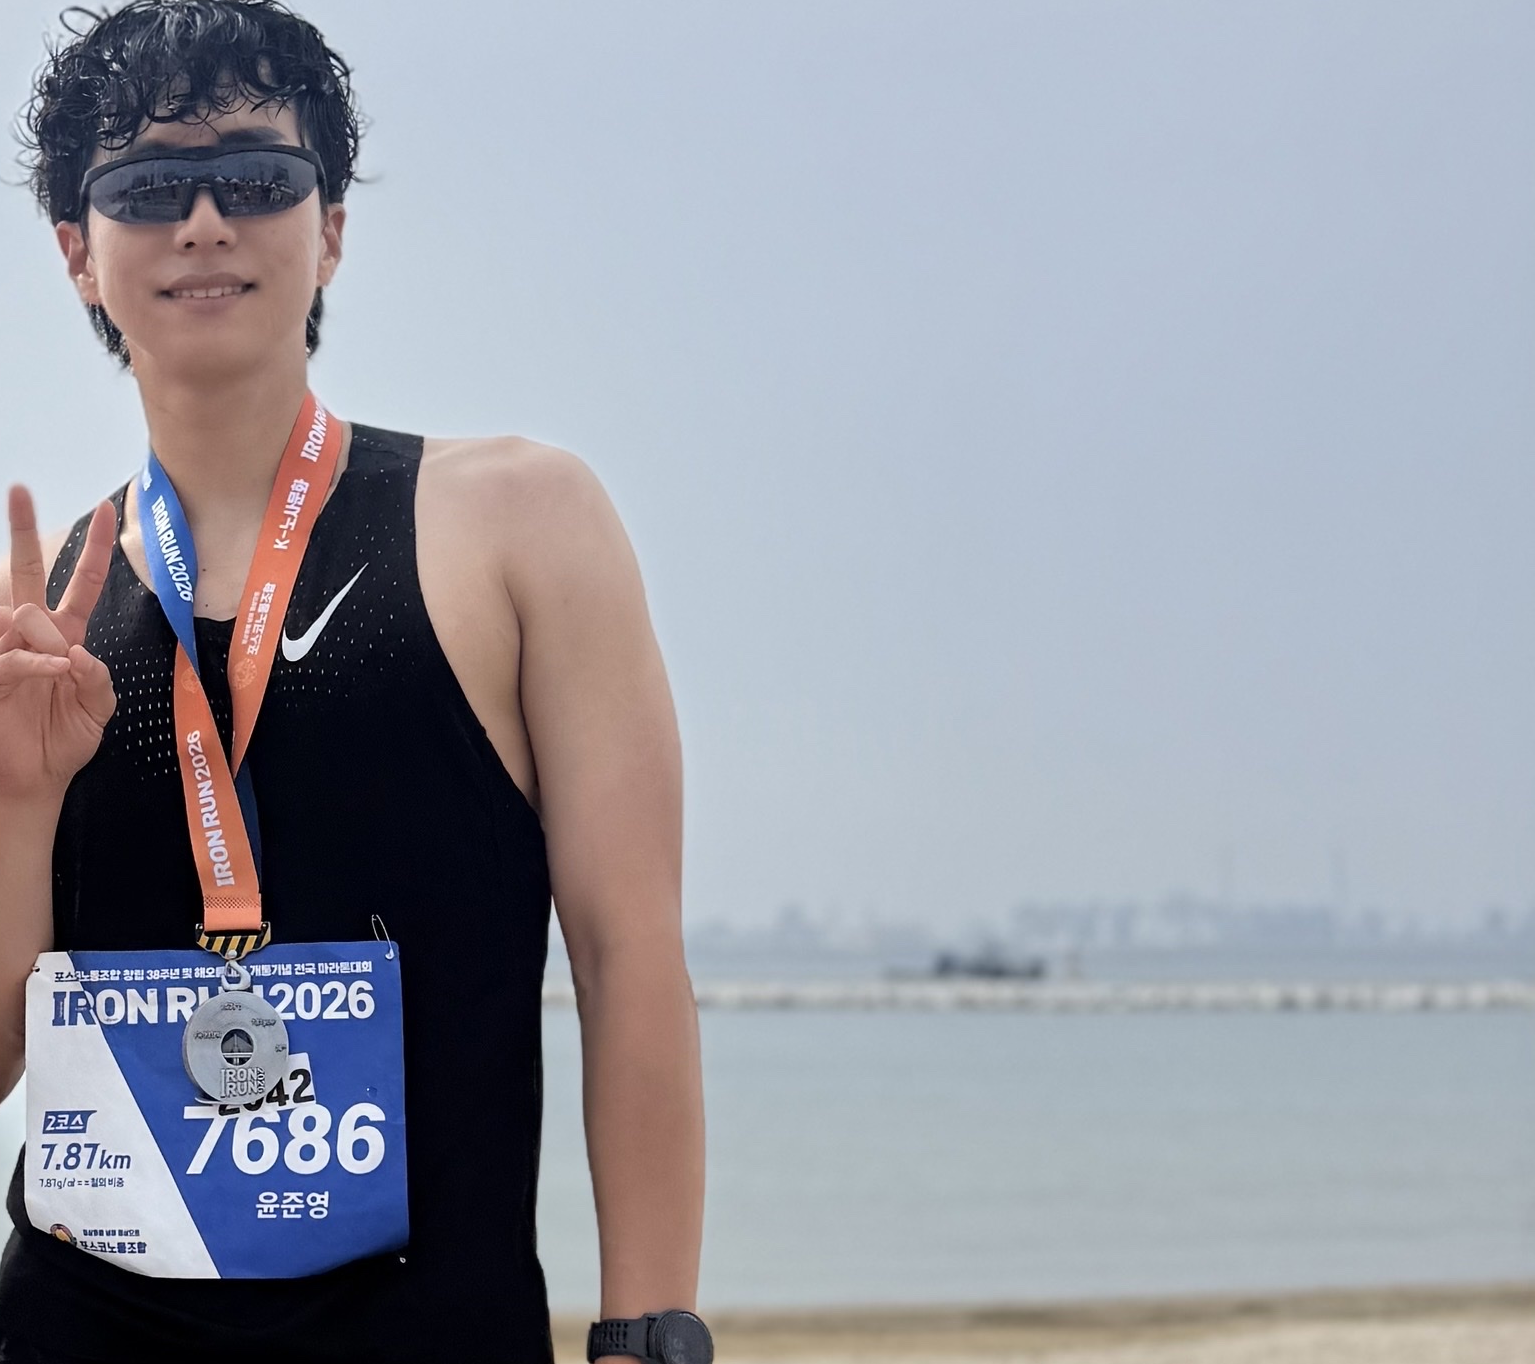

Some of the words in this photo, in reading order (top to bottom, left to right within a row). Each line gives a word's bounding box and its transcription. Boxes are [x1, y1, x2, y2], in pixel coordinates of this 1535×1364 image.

[273, 478, 310, 550] K-노사문화
[205, 829, 235, 886] IRON
[123, 969, 144, 982] 창립
[146, 967, 181, 981] 38주년
[294, 963, 316, 976] 전국
[52, 986, 159, 1027] IRON
[268, 980, 376, 1021] 2026
[45, 1114, 84, 1131] 2코스
[183, 1102, 386, 1176] 7686
[41, 1142, 132, 1170] 7.87km
[256, 1191, 330, 1220] 윤준영
